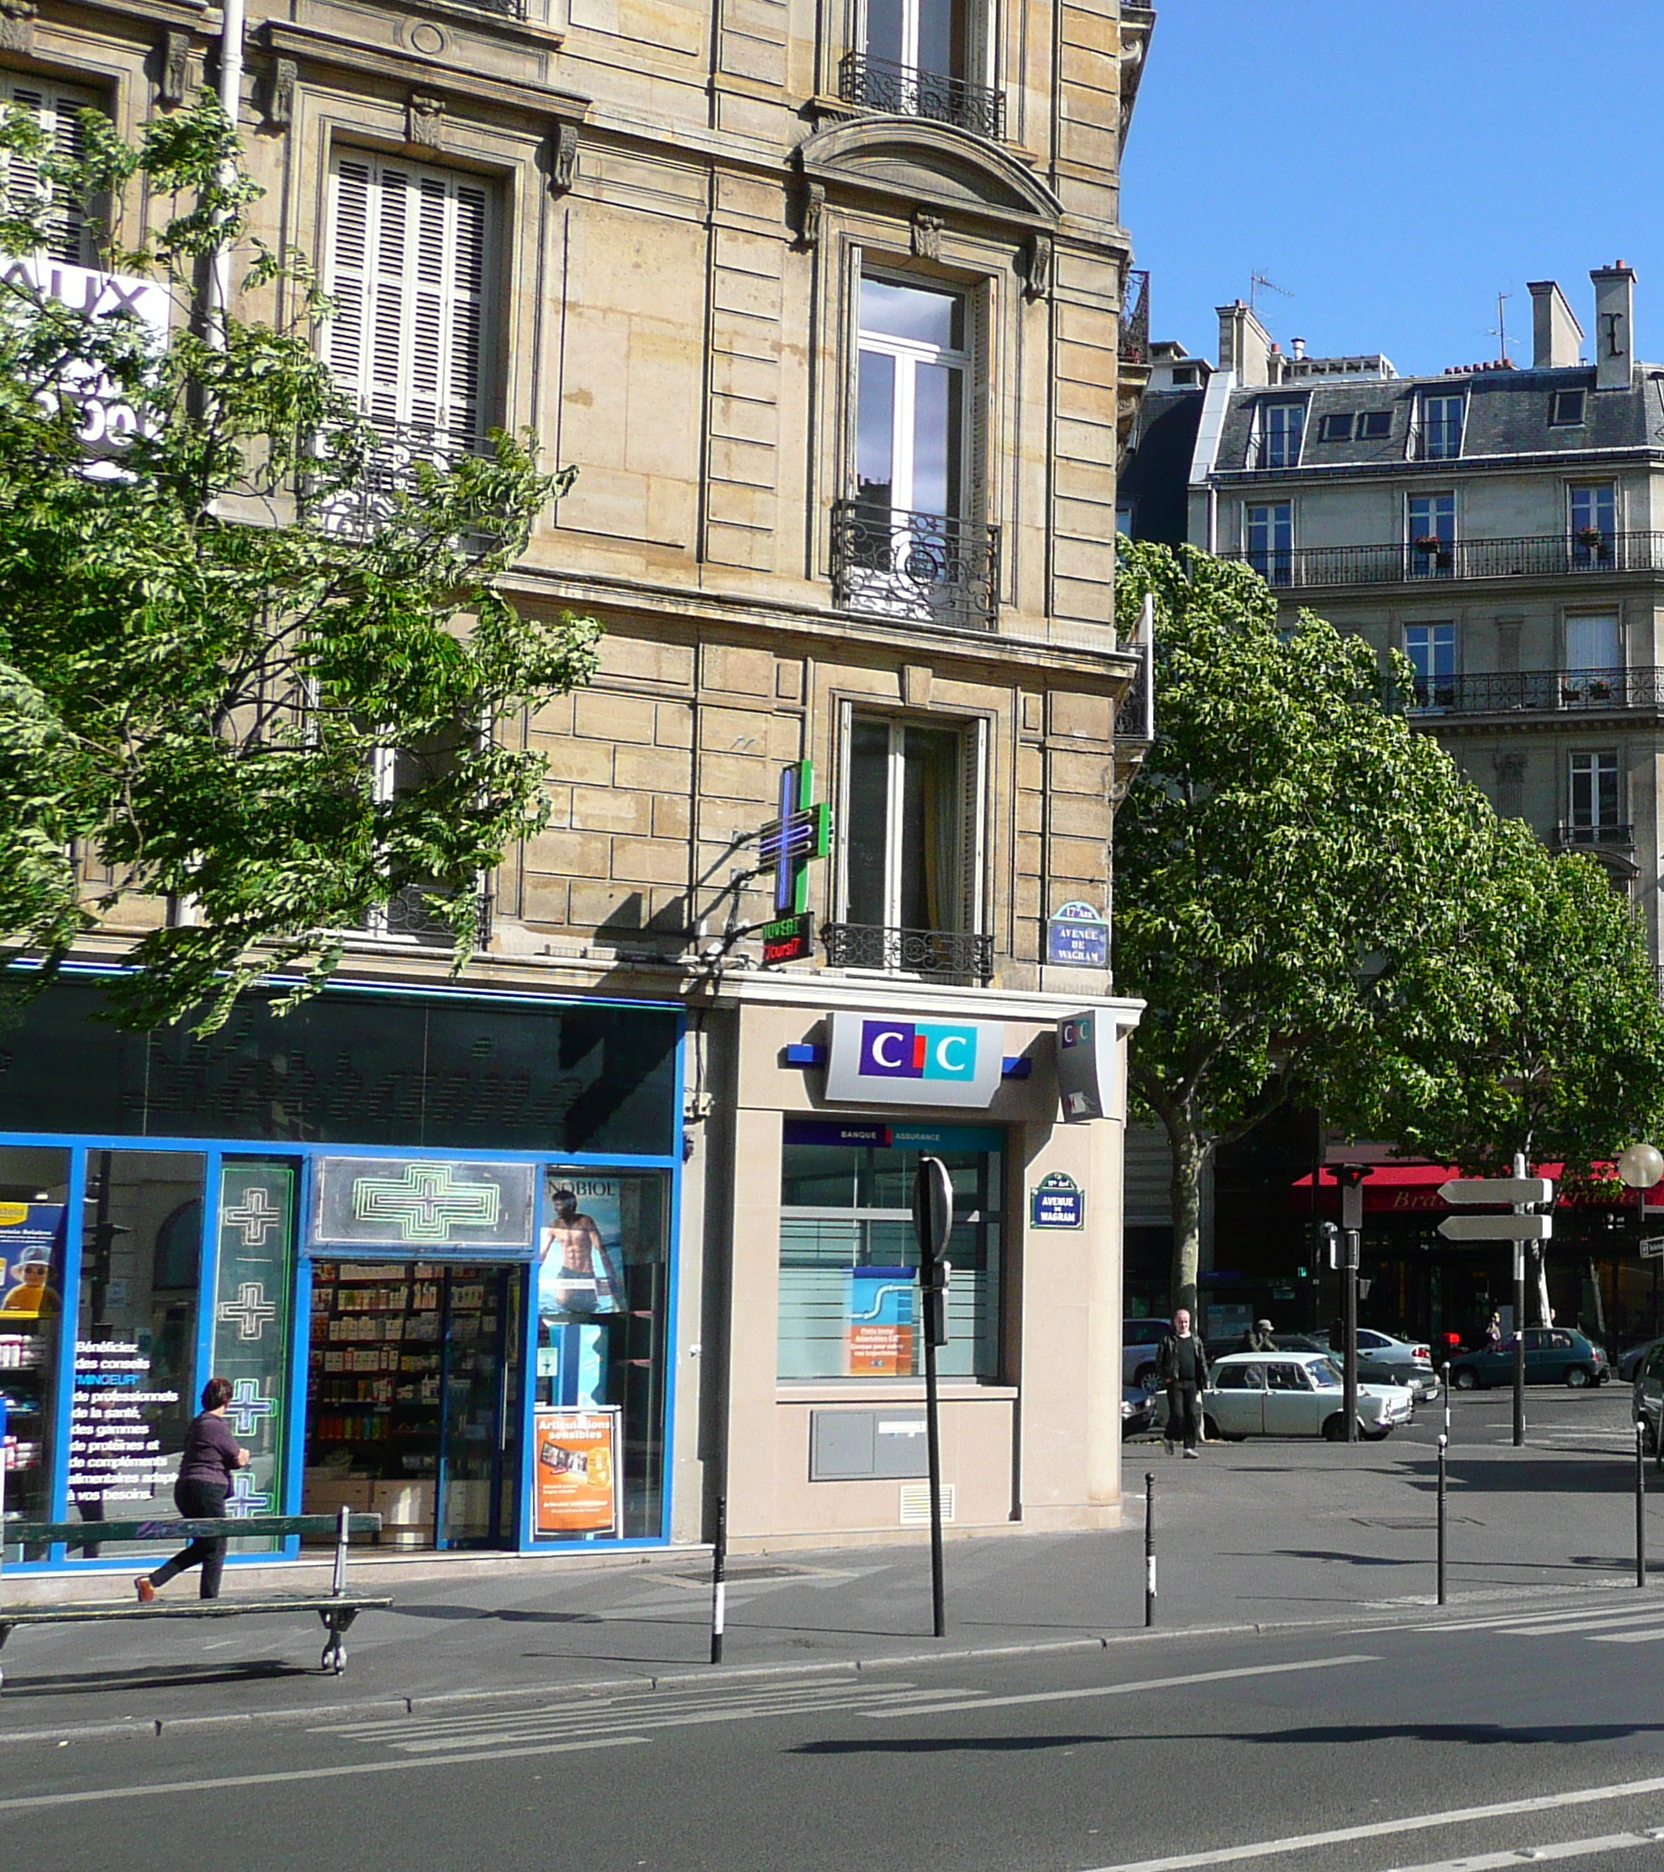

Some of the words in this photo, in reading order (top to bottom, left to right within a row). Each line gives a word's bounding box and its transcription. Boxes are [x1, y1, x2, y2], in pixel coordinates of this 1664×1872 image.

[1060, 928, 1098, 940] AVENUE
[1071, 940, 1085, 949] DE
[1058, 950, 1098, 961] WAGRAM
[872, 1031, 967, 1071] CIC
[841, 1131, 877, 1139] BANQUE
[895, 1132, 941, 1141] ASSURANCE
[1042, 1196, 1074, 1207] AVENUE
[1040, 1212, 1076, 1222] WAGRAM
[75, 1340, 139, 1353] Bénéficiez
[74, 1358, 99, 1369] des
[101, 1358, 150, 1369] conseils
[72, 1390, 89, 1402] de
[91, 1390, 179, 1404] professionnels
[72, 1407, 88, 1418] de
[90, 1407, 102, 1418] la
[104, 1406, 141, 1419] santé,
[71, 1423, 94, 1435] des
[96, 1424, 149, 1437] gammes
[538, 1420, 611, 1430] Articulations
[548, 1430, 603, 1440] sensibles
[70, 1440, 86, 1451] de
[146, 1440, 160, 1451] et
[69, 1457, 85, 1468] de
[87, 1456, 168, 1469] compléments
[68, 1473, 139, 1484] alimentaires
[67, 1489, 75, 1501] à
[78, 1491, 100, 1501] vos
[103, 1489, 153, 1500] besoins.
